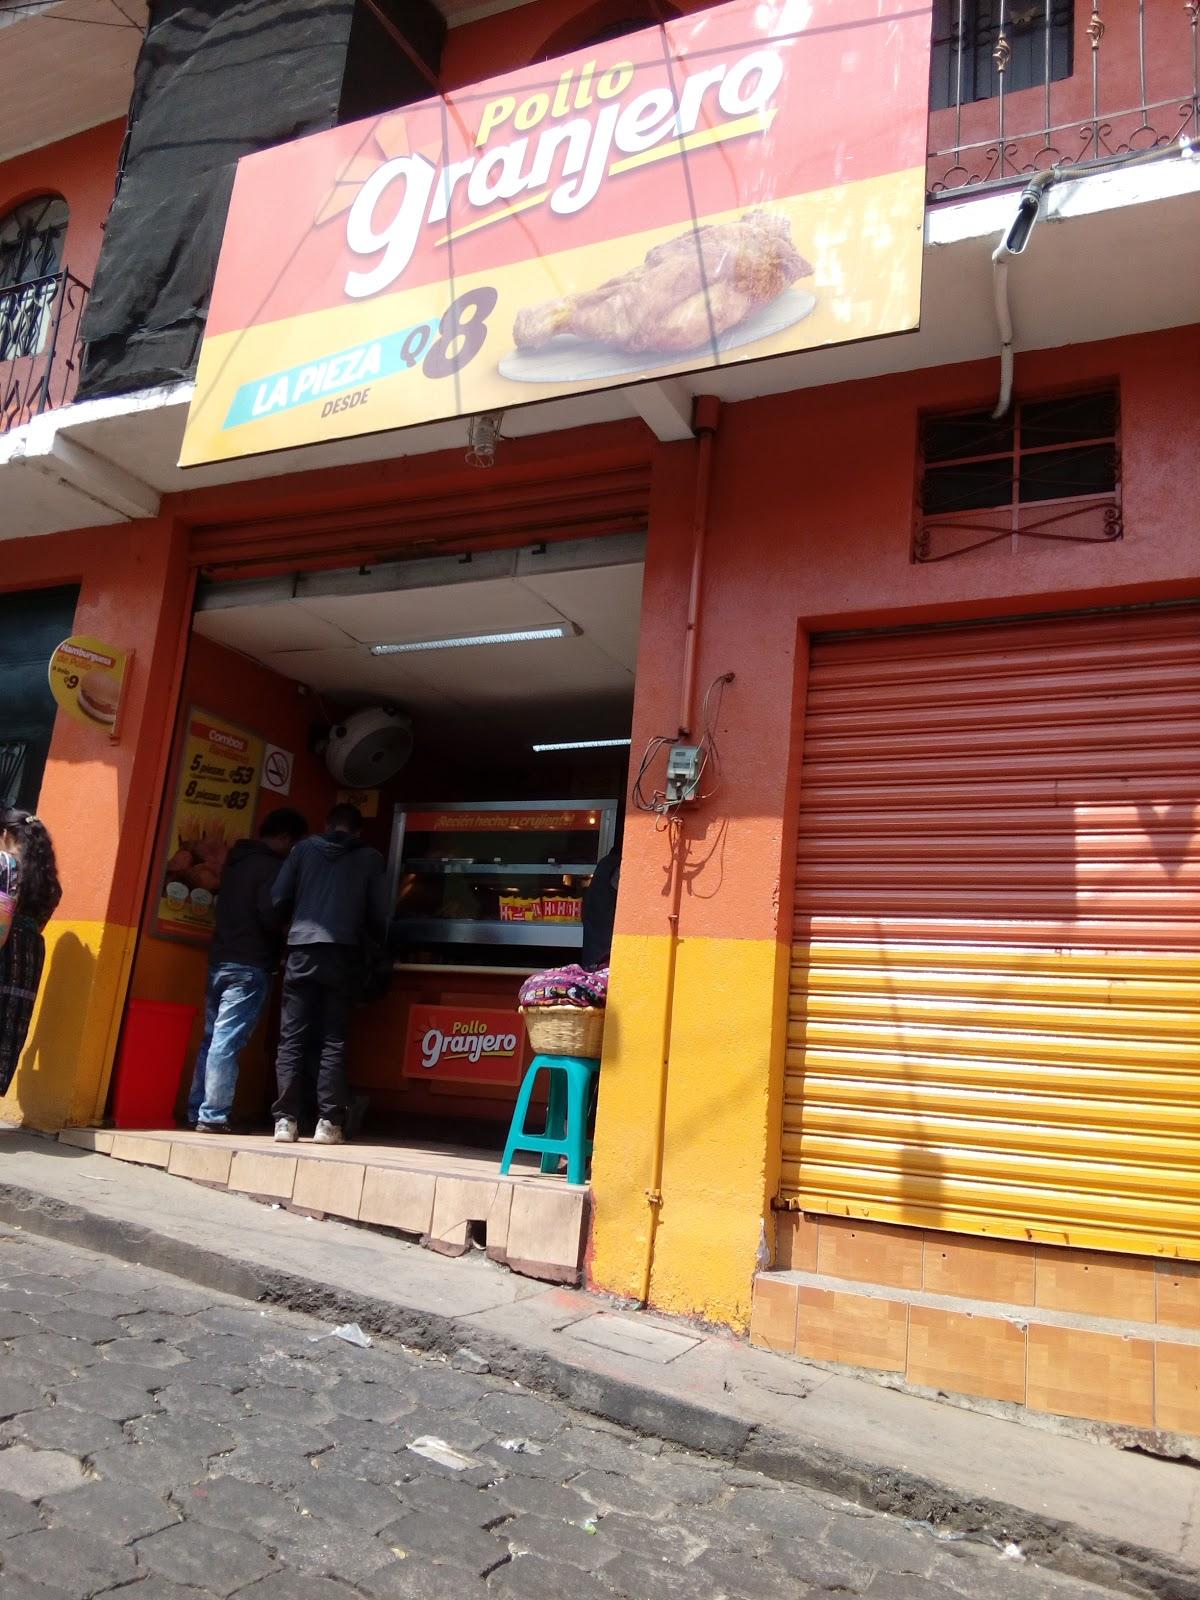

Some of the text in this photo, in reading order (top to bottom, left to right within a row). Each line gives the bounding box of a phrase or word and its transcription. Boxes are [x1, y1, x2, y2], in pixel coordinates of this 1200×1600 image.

[475, 59, 635, 148] Pollo
[344, 50, 785, 298] granjero
[251, 371, 288, 416] LA
[291, 342, 383, 403] PIEZA
[320, 387, 371, 419] DESDE
[209, 730, 244, 749] Combos
[190, 754, 204, 771] 5
[186, 780, 197, 797] 8
[453, 1020, 488, 1034] Pollo
[421, 1029, 517, 1068] granjero
